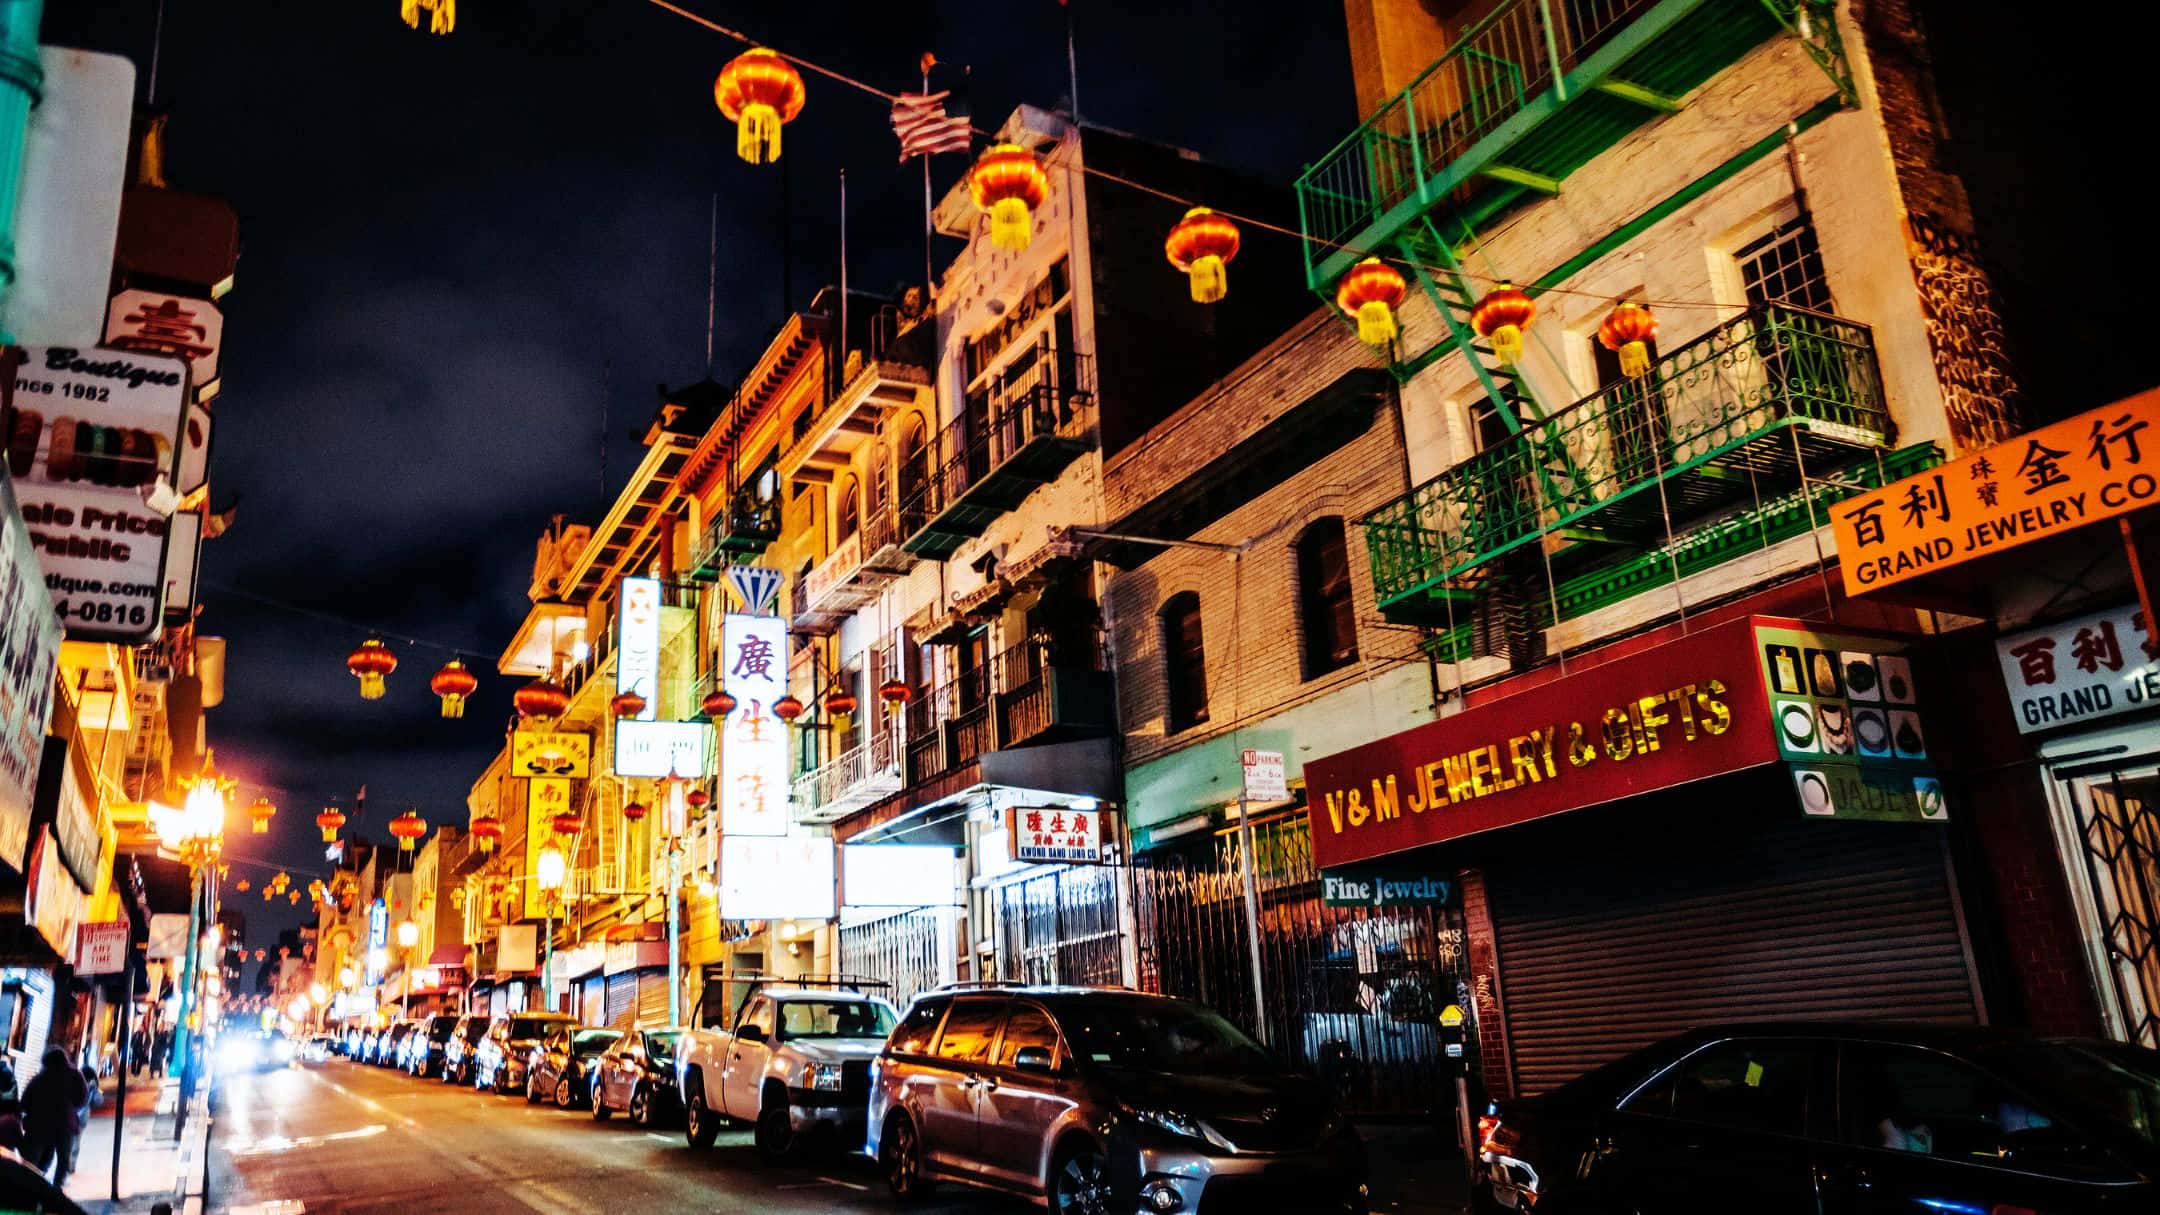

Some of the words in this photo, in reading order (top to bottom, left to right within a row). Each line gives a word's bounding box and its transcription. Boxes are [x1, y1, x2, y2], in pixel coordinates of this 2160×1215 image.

[45, 347, 180, 388] Boutique
[15, 377, 54, 395] nce
[62, 381, 110, 402] 1982
[81, 506, 165, 536] Price
[1857, 537, 1954, 585] GRAND
[1964, 491, 2087, 551] JEWELRY
[2100, 473, 2157, 508] CO
[45, 573, 157, 598] tique.com
[56, 599, 146, 625] 4-0816
[2022, 684, 2113, 726] GRAND
[1244, 751, 1256, 764] NO
[1408, 723, 1557, 813] JEWELRY
[1568, 722, 1597, 767] &
[1602, 680, 1731, 761] GIFTS
[1324, 877, 1370, 901] Fine
[1373, 876, 1450, 906] Jewelry
